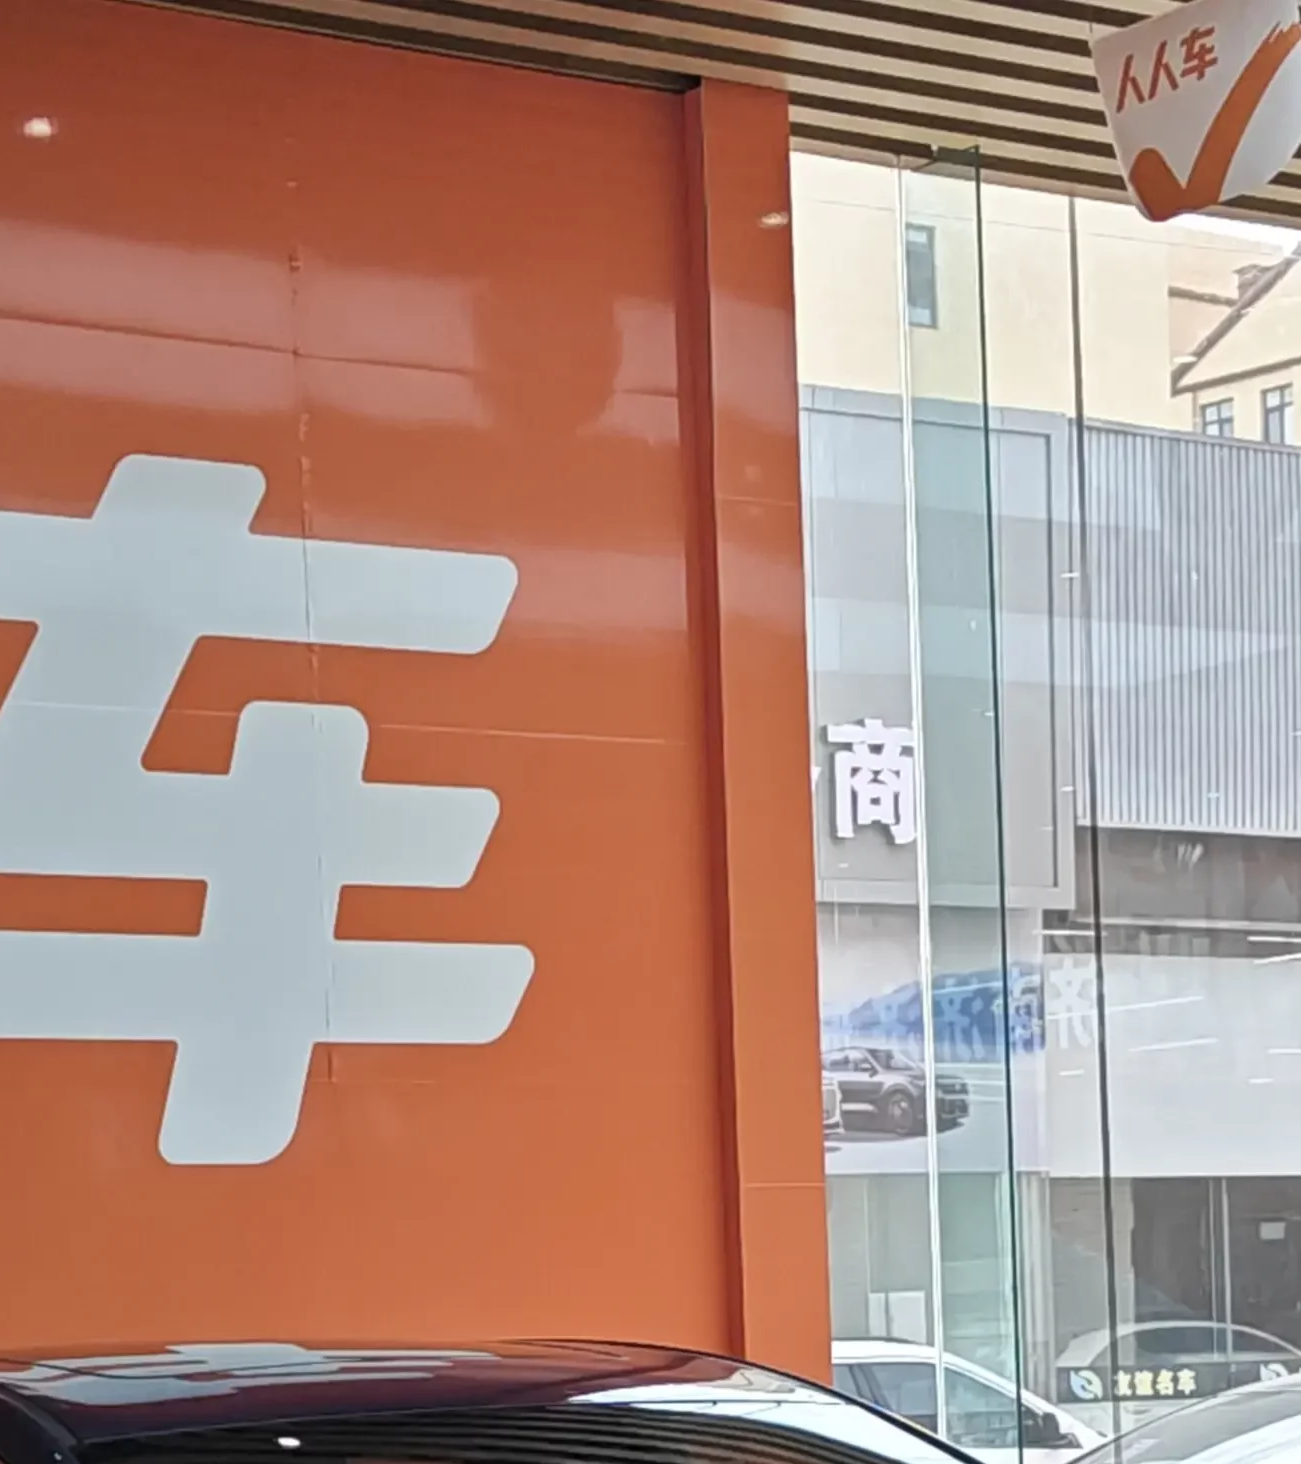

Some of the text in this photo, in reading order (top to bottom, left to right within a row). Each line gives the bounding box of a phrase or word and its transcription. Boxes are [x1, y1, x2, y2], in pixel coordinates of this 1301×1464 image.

[1116, 26, 1218, 113] 人人车
[815, 719, 918, 845] 商
